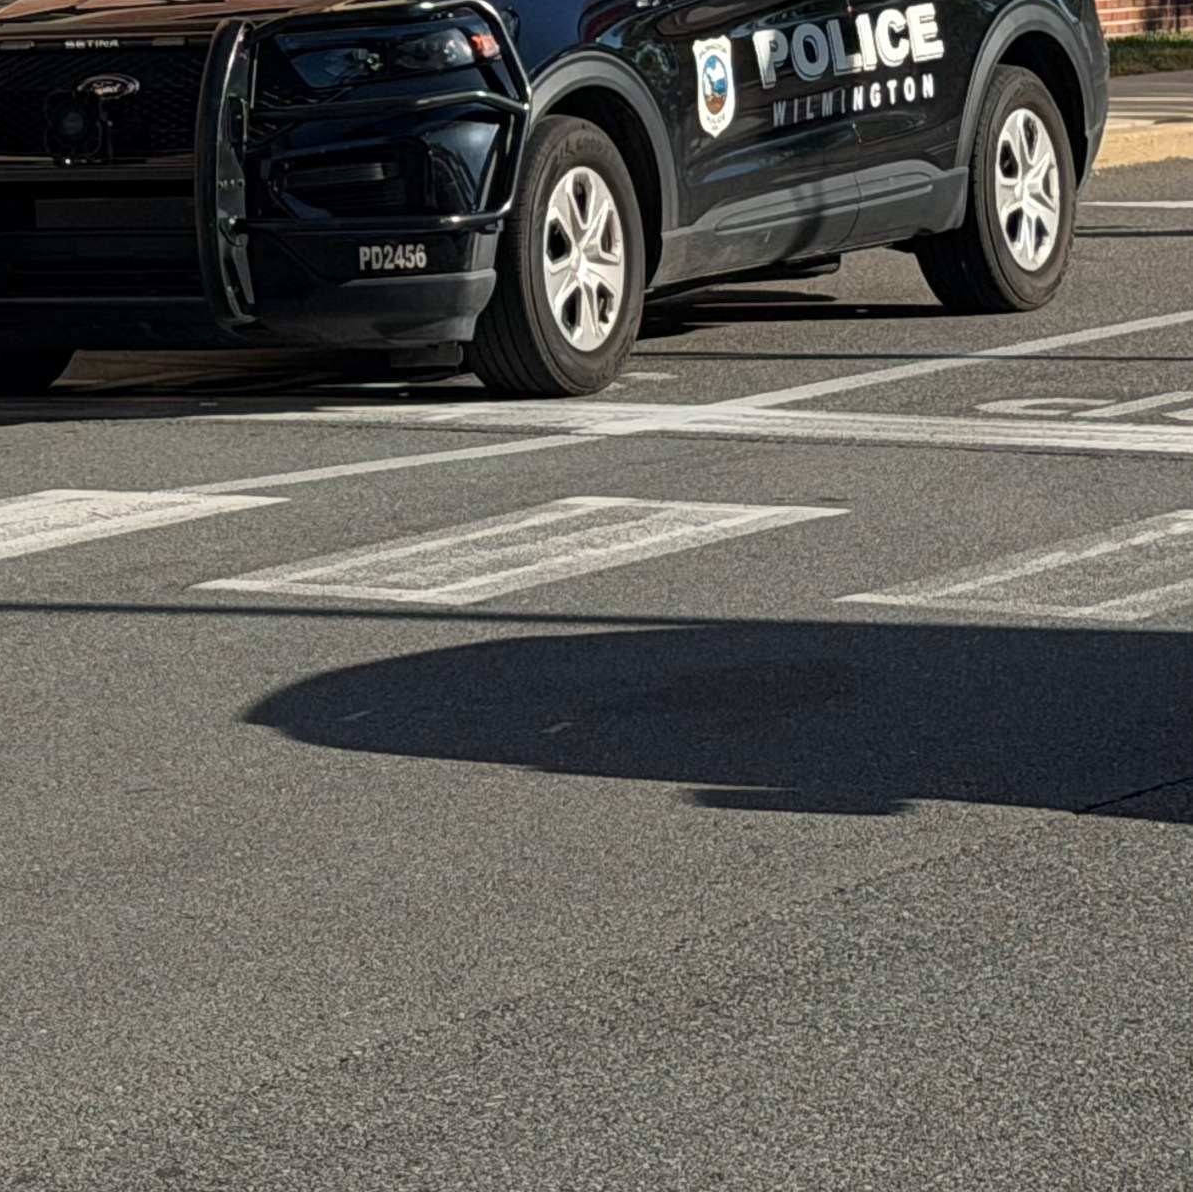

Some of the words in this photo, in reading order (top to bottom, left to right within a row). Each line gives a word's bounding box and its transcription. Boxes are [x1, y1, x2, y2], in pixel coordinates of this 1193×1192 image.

[752, 2, 945, 90] POLICE
[773, 73, 935, 128] WILMINGTON
[358, 243, 428, 271] PD2456
